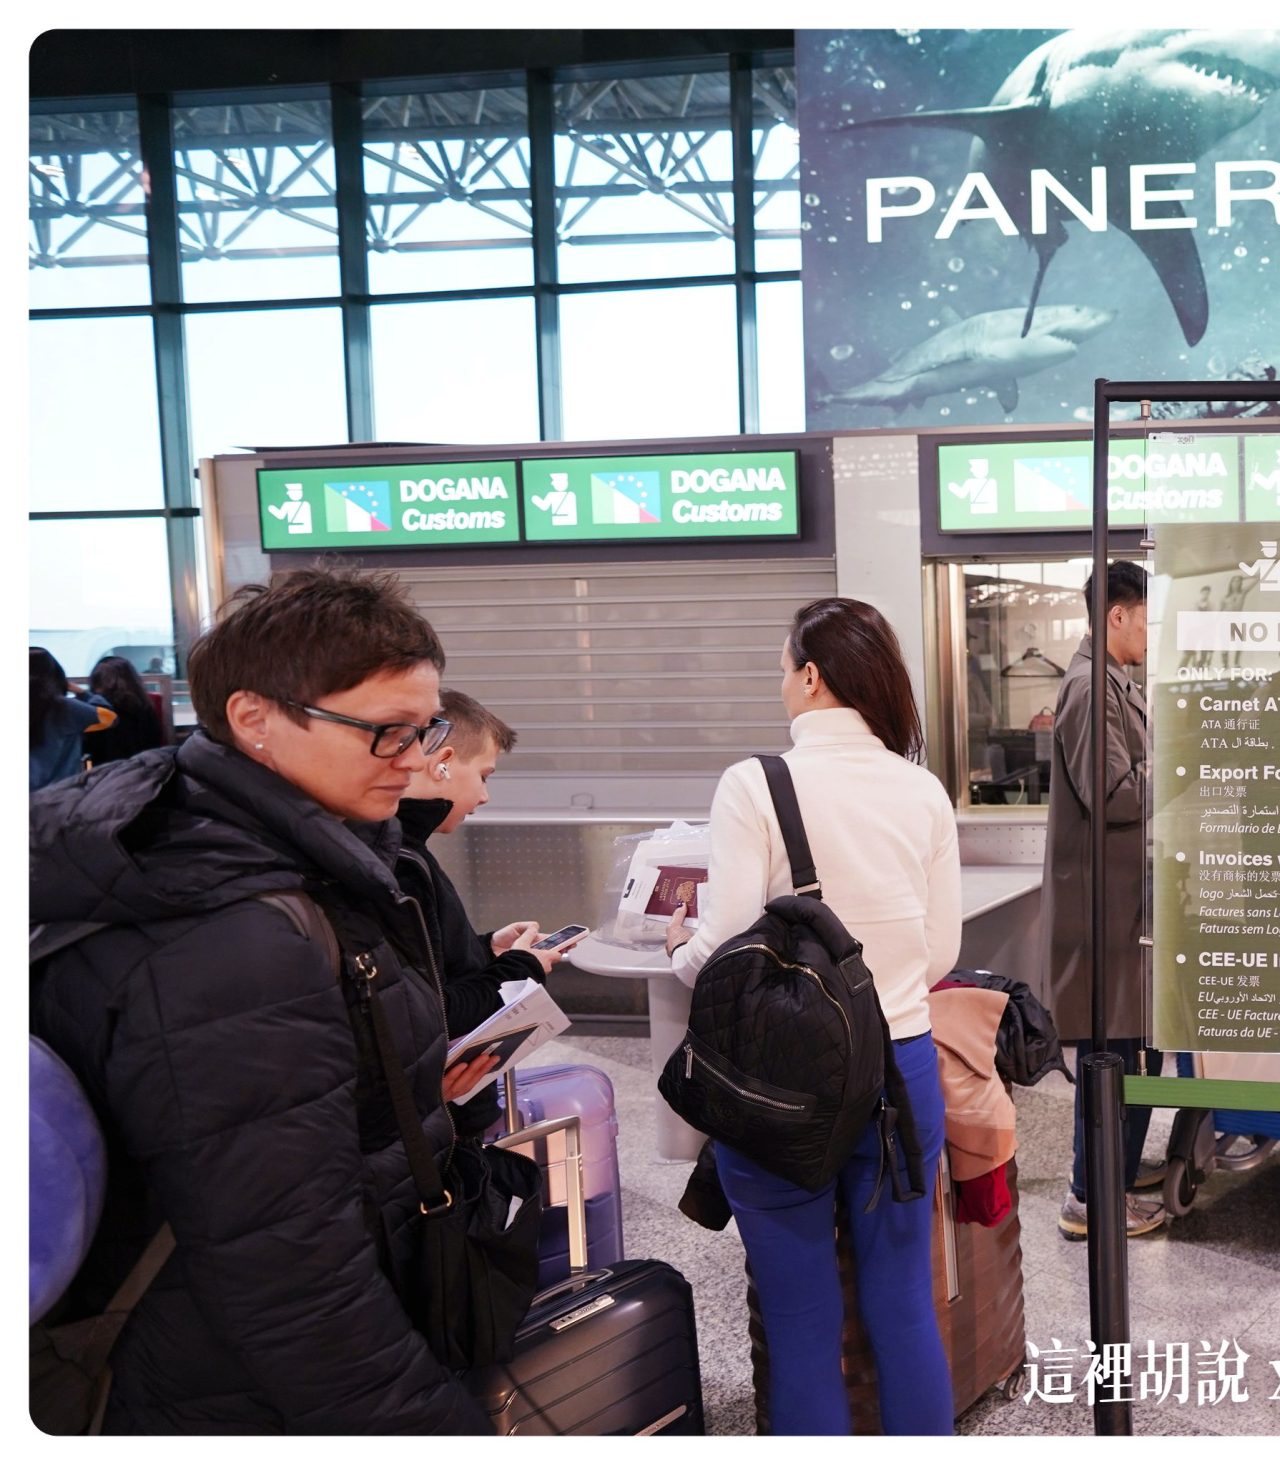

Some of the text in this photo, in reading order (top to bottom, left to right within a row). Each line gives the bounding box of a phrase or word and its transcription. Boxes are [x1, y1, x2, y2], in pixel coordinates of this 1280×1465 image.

[1107, 452, 1228, 480] DOGANA
[671, 467, 787, 494] DOGANA
[400, 476, 509, 503] DOGANA
[1107, 486, 1224, 511] Customs
[402, 507, 506, 531] Customs
[672, 499, 783, 524] Customs
[1229, 621, 1269, 644] NO
[1177, 667, 1273, 682] ONLY FOR:
[1199, 696, 1260, 711] Carnet
[1201, 718, 1260, 731] ATA 通行证
[1200, 738, 1228, 749] ATA
[1199, 764, 1259, 783] Export
[1199, 785, 1247, 798] 出口发票
[1199, 822, 1260, 834] Formulario
[1261, 823, 1276, 834] de
[1199, 850, 1273, 867] Invoices
[1199, 887, 1224, 901] logo
[1199, 905, 1245, 918] Factures
[1246, 908, 1271, 918] sans
[1199, 922, 1240, 934] Faturas
[1241, 926, 1264, 935] sem
[1199, 952, 1268, 968] CEE-UE
[1198, 975, 1261, 987] CEE-UE 发票
[1197, 1008, 1220, 1020] CEE
[1227, 1009, 1242, 1021] UE
[1197, 1025, 1238, 1038] Faturas
[1239, 1026, 1254, 1038] da
[1256, 1027, 1273, 1038] UE
